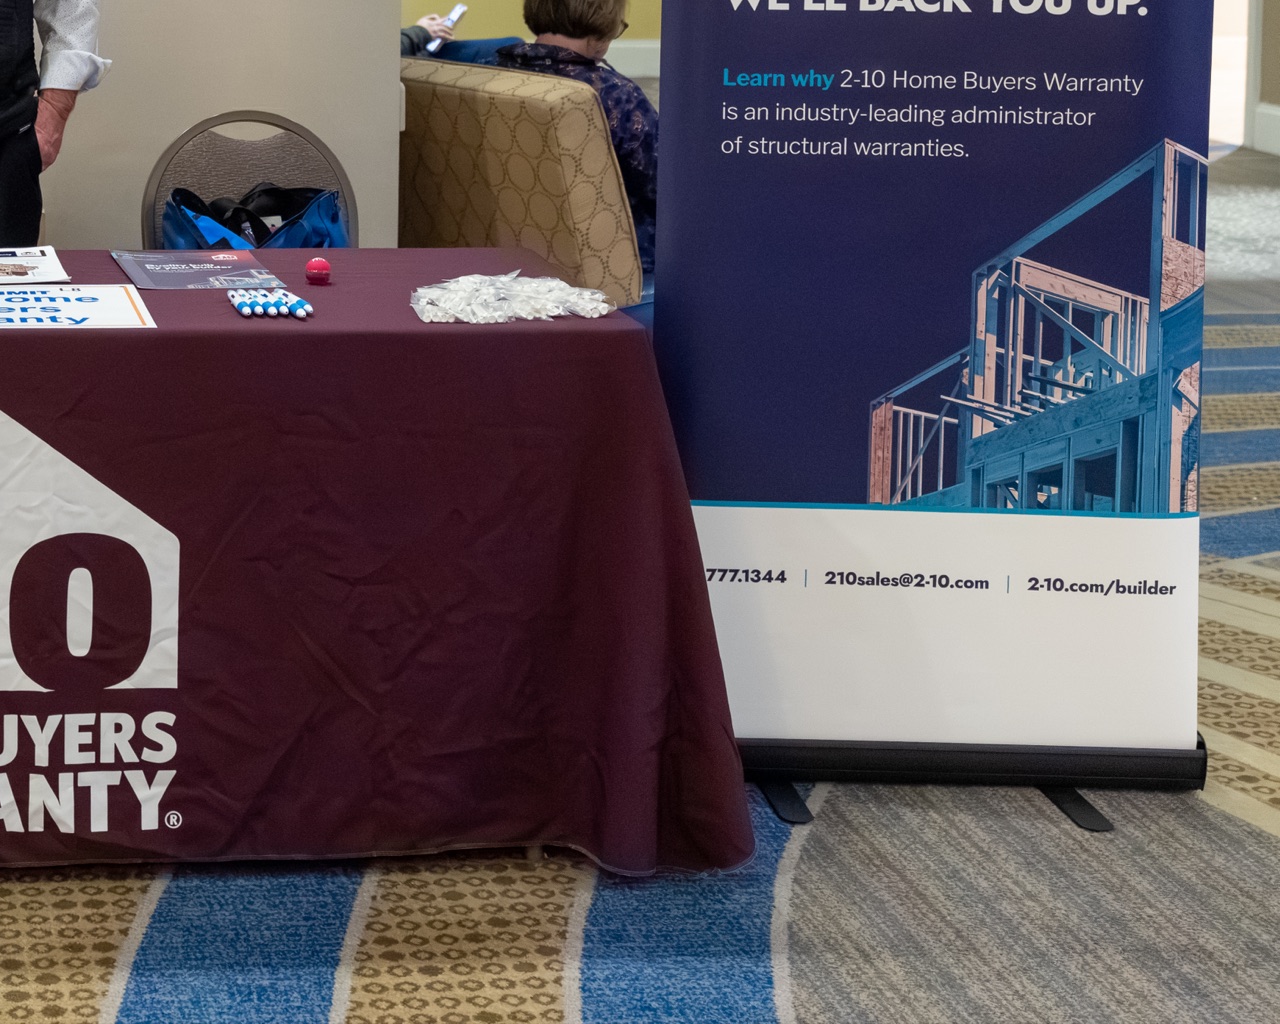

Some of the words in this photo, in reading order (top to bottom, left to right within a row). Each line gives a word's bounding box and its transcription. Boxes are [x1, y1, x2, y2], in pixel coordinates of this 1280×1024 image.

[723, 67, 786, 87] Learn
[790, 69, 835, 91] why
[840, 69, 886, 89] 2-10
[893, 69, 957, 90] Home
[963, 71, 1037, 94] Buyers
[1043, 72, 1144, 96] Warranty
[722, 101, 738, 121] is
[743, 106, 769, 121] an
[775, 102, 946, 127] industry-leading
[951, 105, 1097, 126] administrator
[721, 135, 743, 154] of
[747, 136, 848, 156] structural
[853, 138, 969, 158] warranties.
[824, 570, 990, 590] 210sales@2-10.com
[1027, 576, 1177, 597] 2-10.com/builder
